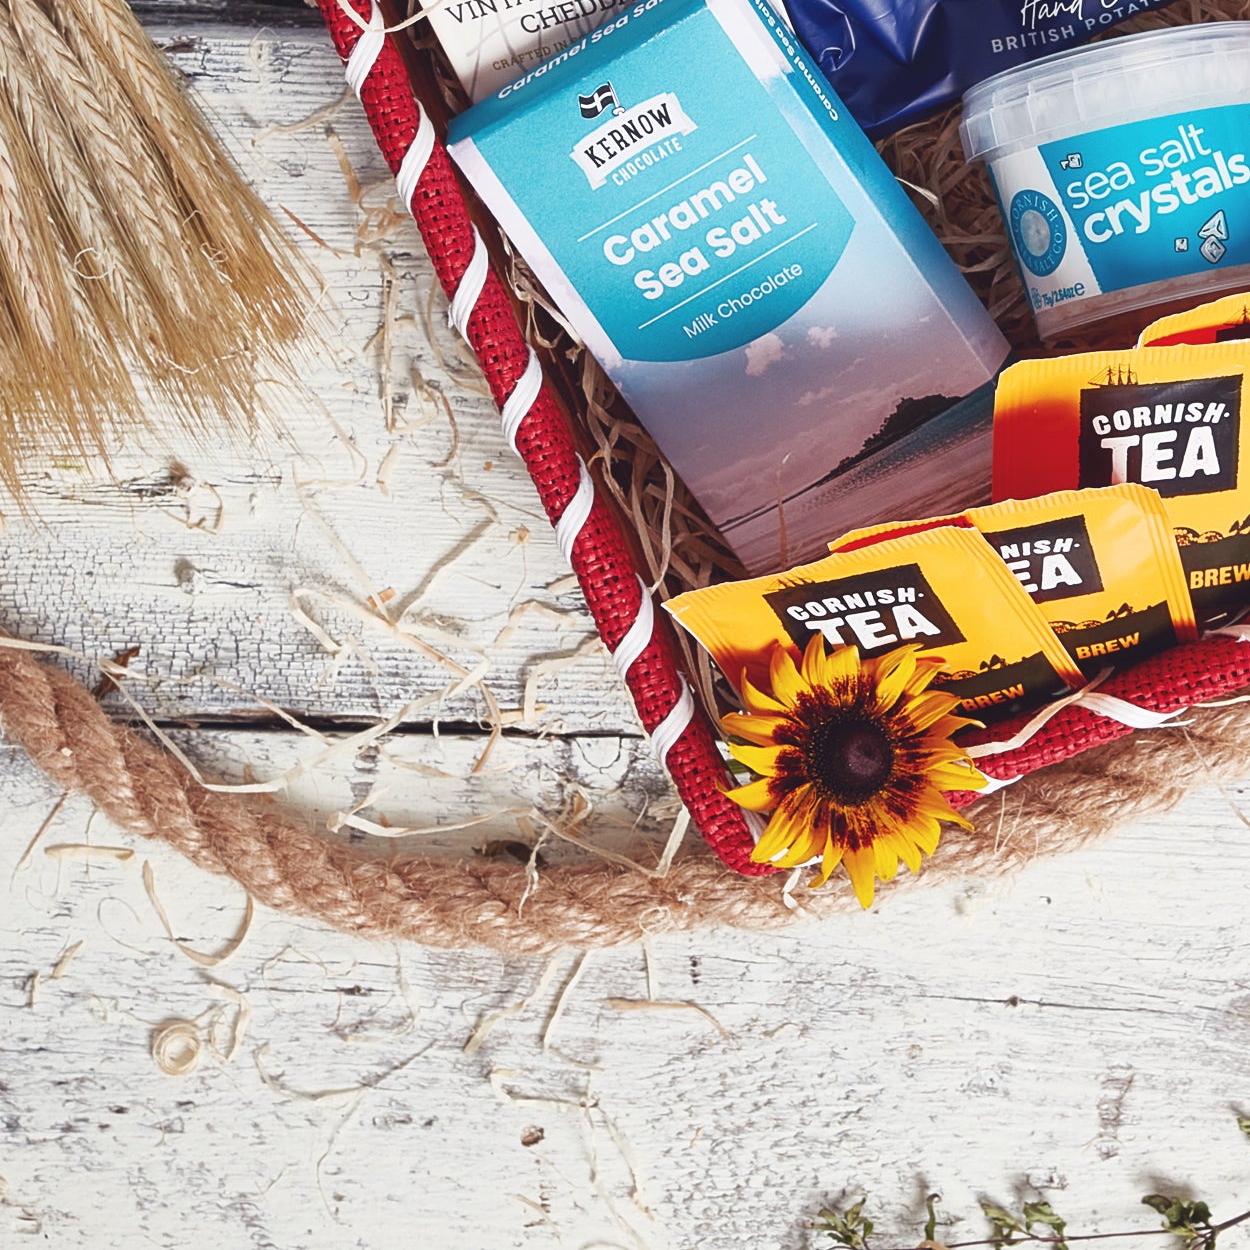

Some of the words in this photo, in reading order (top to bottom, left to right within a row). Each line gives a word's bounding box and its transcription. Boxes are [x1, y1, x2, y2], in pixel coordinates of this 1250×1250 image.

[491, 44, 552, 72] CRAFTED
[497, 38, 587, 100] Caramel
[591, 15, 629, 44] Sea
[775, 26, 796, 57] Sea
[991, 24, 1076, 54] BRITISH
[793, 56, 840, 122] Caramel
[583, 102, 673, 170] KERNOW
[611, 137, 684, 187] CHOCOLATE
[1066, 161, 1136, 210] sea
[1139, 123, 1212, 177] salt
[603, 153, 768, 266] Caramel
[633, 246, 711, 301] Sea
[705, 198, 788, 259] Salt
[682, 310, 719, 339] Milk
[717, 262, 804, 319] Chocolate
[1100, 425, 1221, 486] TEA
[1000, 537, 1074, 560] NISH
[1005, 553, 1083, 593] EA
[804, 603, 942, 651] TEA
[1074, 630, 1141, 660] BREW
[960, 682, 1025, 713] BREW
